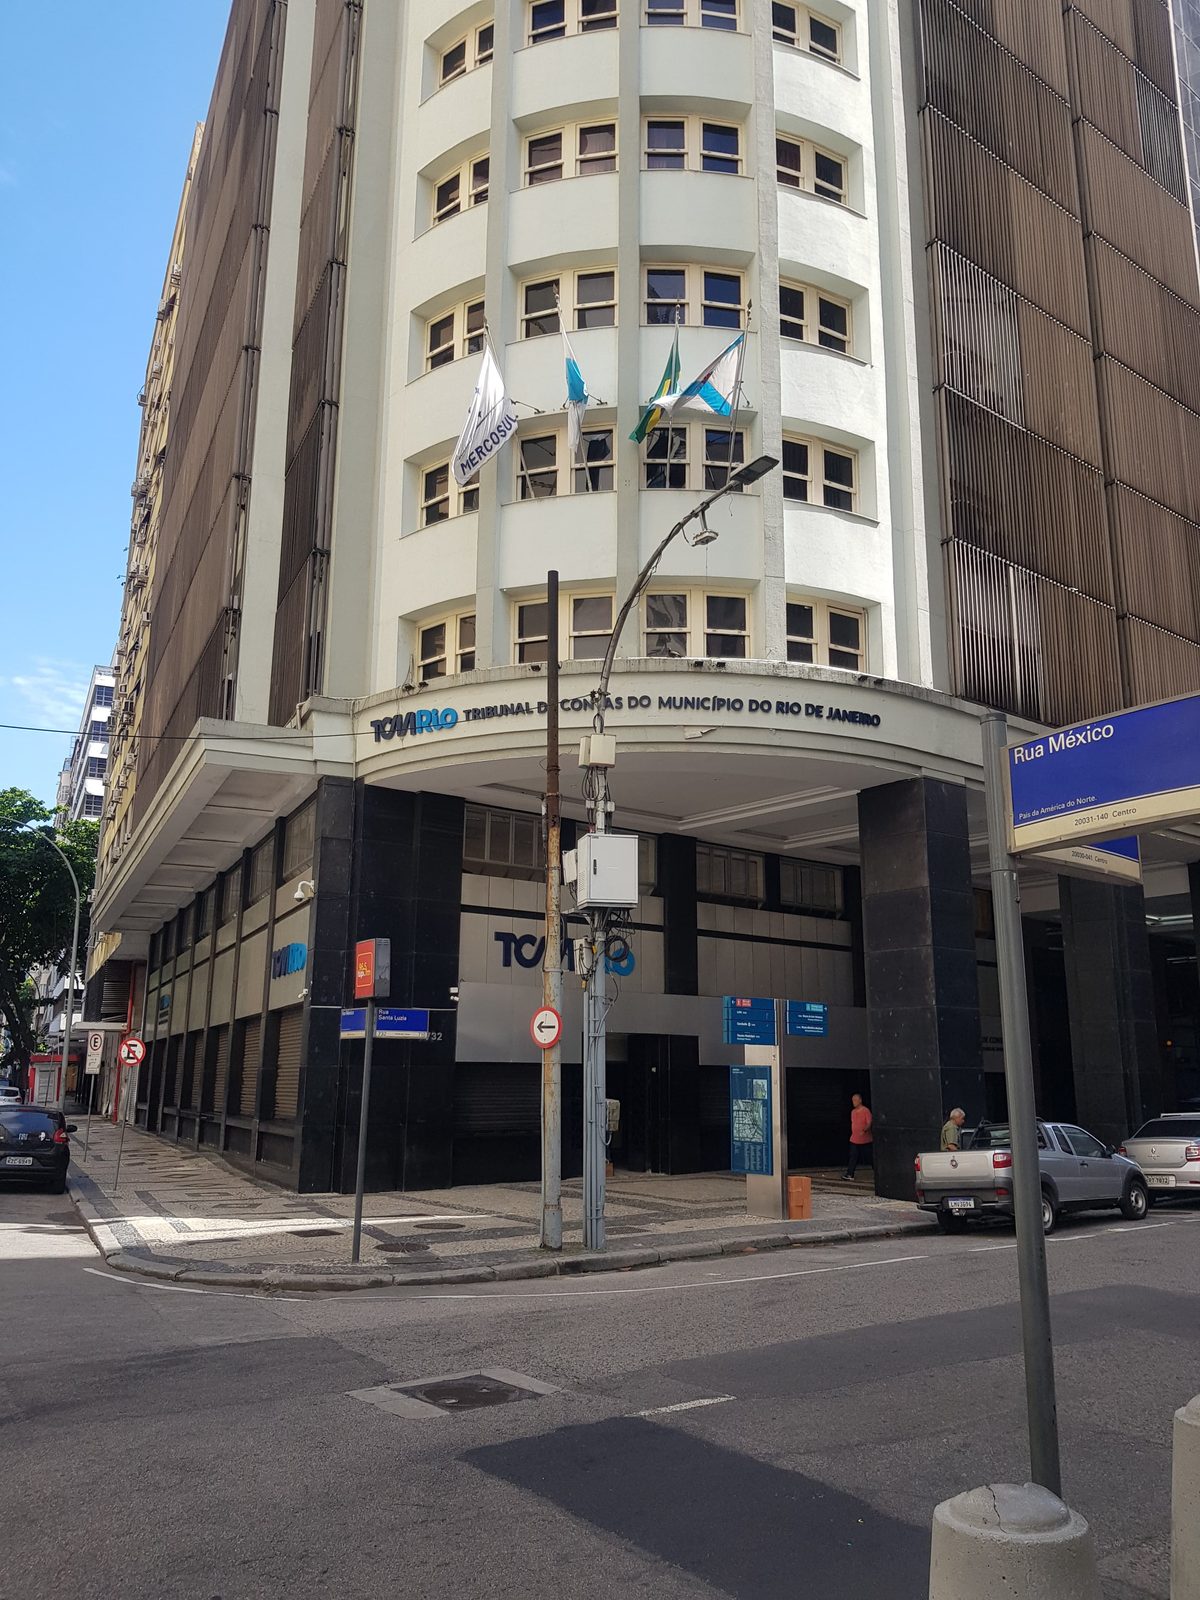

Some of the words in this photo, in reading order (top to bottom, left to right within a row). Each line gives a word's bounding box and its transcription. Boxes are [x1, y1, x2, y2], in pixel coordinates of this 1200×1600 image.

[460, 414, 517, 476] MERCOSUL
[463, 702, 533, 721] TRIBUNAL
[560, 696, 623, 712] CONAS
[628, 695, 651, 710] DO
[658, 695, 743, 712] MUNICÍPIO
[748, 699, 772, 713] DO
[775, 701, 801, 715] RIO
[805, 705, 823, 719] DE
[826, 707, 881, 726] JANEIRO
[1014, 744, 1044, 764] Rua
[1048, 724, 1114, 753] México
[1032, 809, 1040, 817] da
[1040, 802, 1065, 814] América
[1066, 800, 1075, 808] do
[1074, 812, 1108, 826] 20031-140
[1112, 808, 1137, 818] Centro
